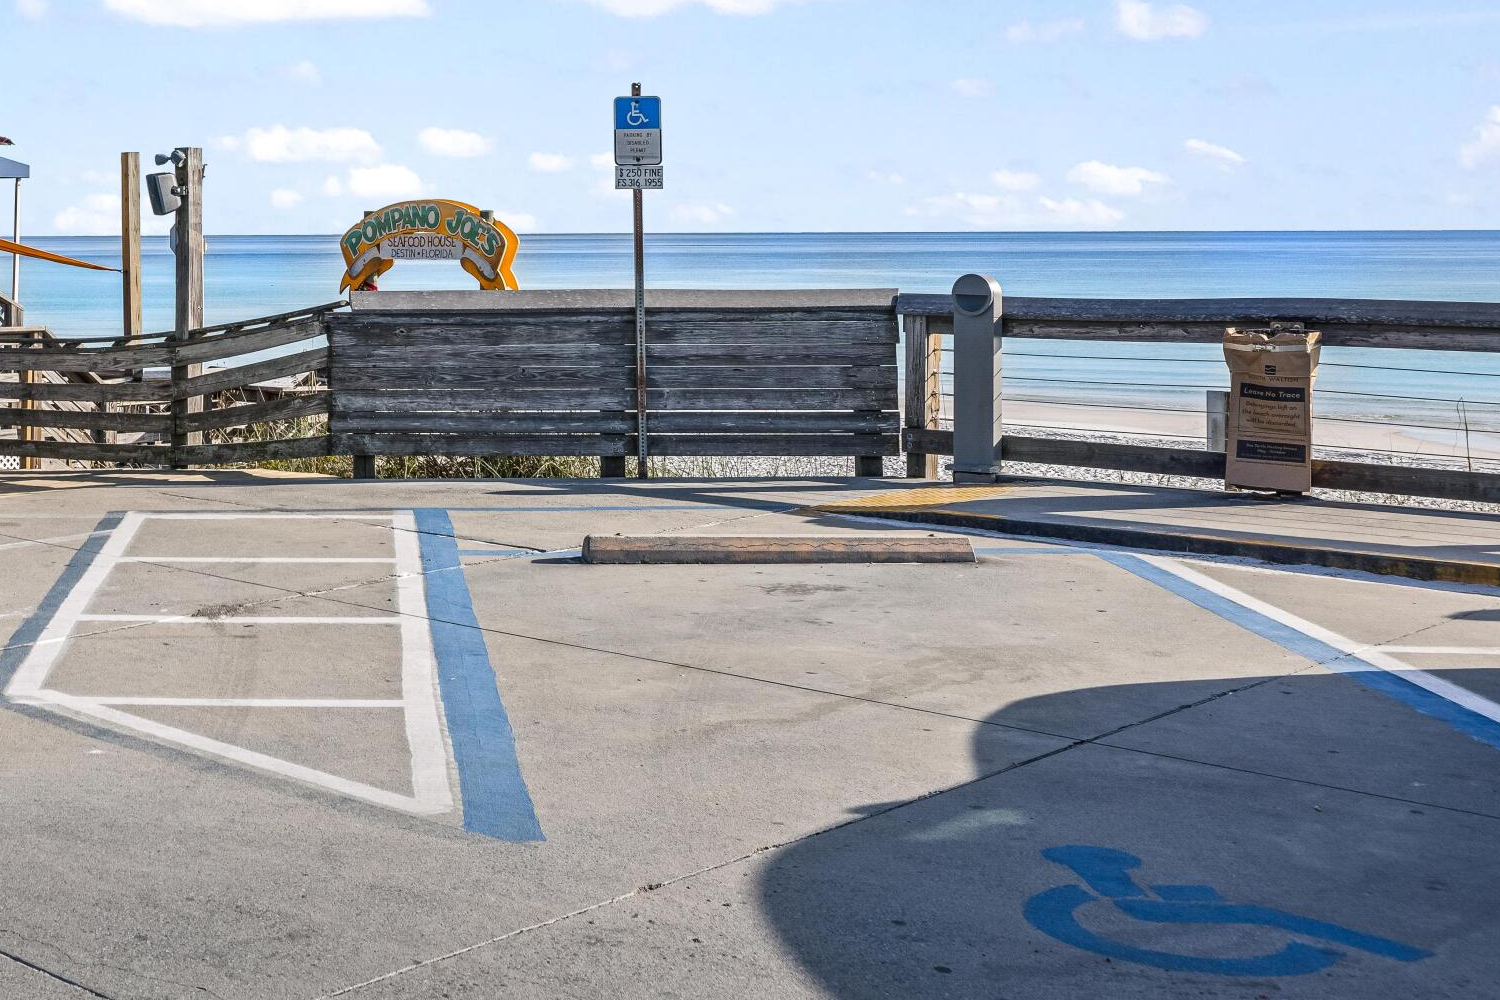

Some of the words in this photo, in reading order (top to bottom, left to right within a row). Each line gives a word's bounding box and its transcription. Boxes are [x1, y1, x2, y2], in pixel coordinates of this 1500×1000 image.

[644, 168, 662, 178] FINE
[344, 203, 442, 258] POMPANO
[445, 210, 501, 258] JOE'S
[387, 234, 426, 248] SEAFOOD
[427, 234, 457, 248] HOUSE
[391, 248, 416, 258] DESTIN
[421, 249, 453, 258] FLORIDA
[1243, 387, 1264, 396] Leave
[1279, 391, 1301, 399] Trace
